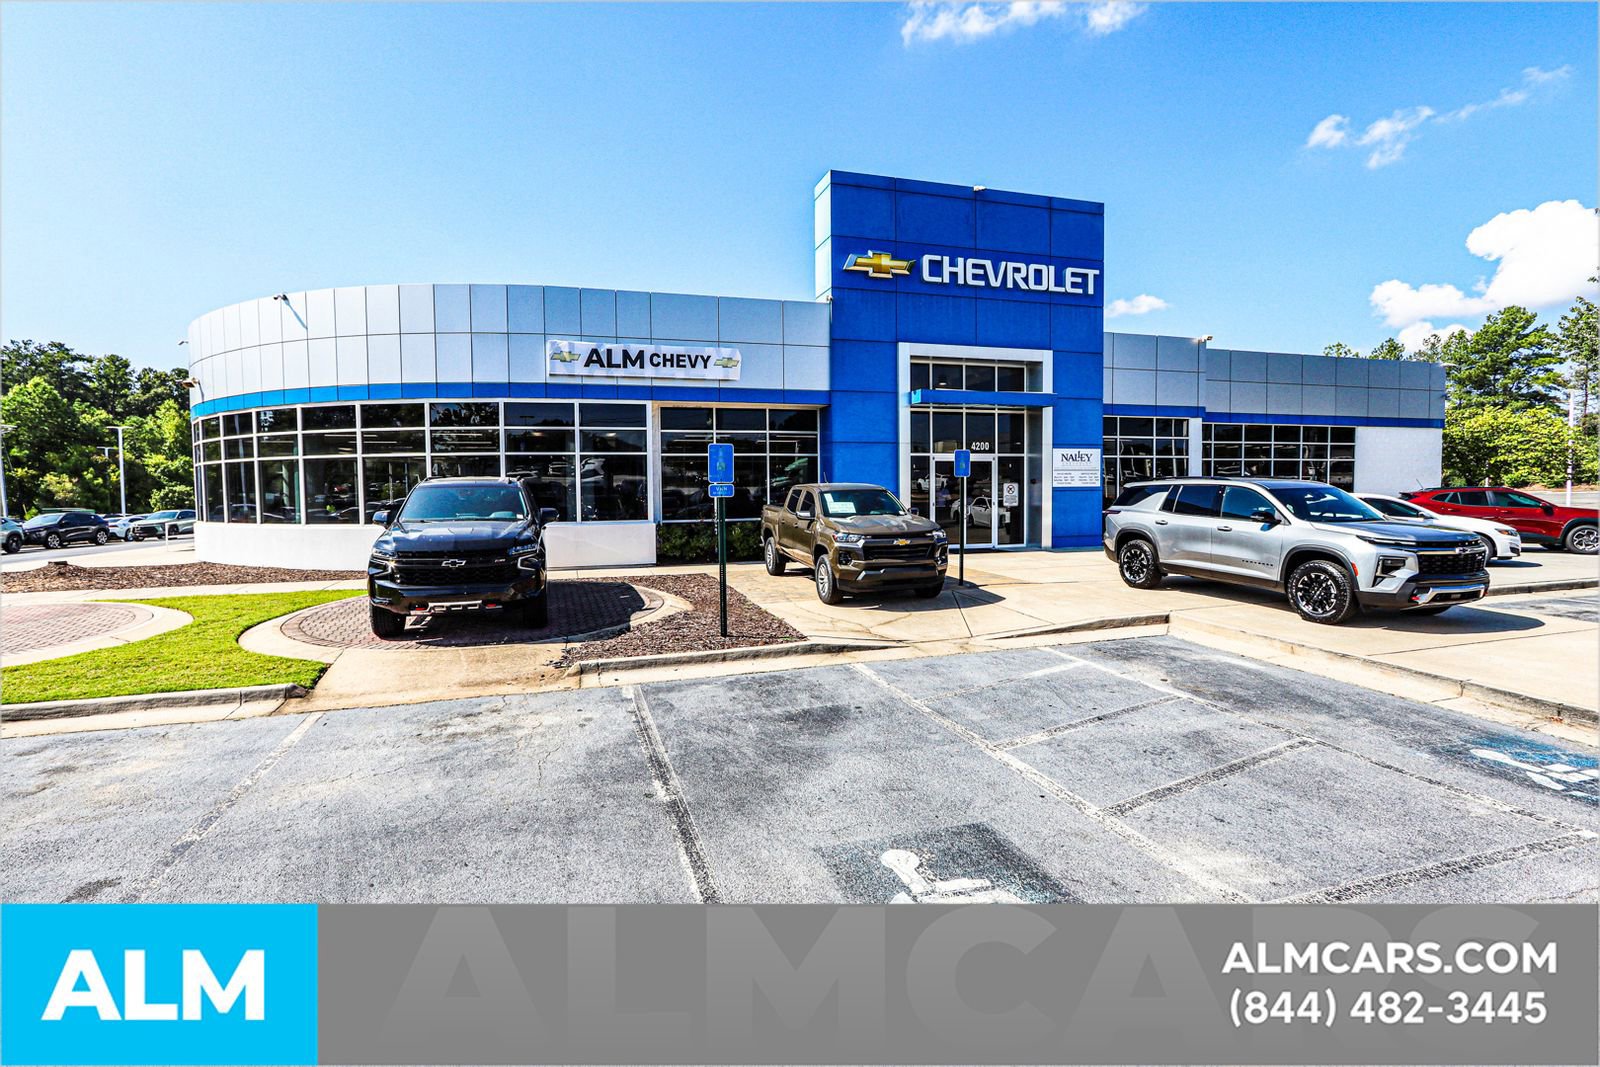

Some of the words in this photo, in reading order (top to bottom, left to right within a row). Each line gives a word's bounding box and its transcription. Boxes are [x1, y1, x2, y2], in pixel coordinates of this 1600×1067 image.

[921, 254, 1100, 295] CHEVROLET
[583, 348, 645, 369] ALM
[649, 353, 711, 369] CHEVY
[971, 442, 990, 451] 4200
